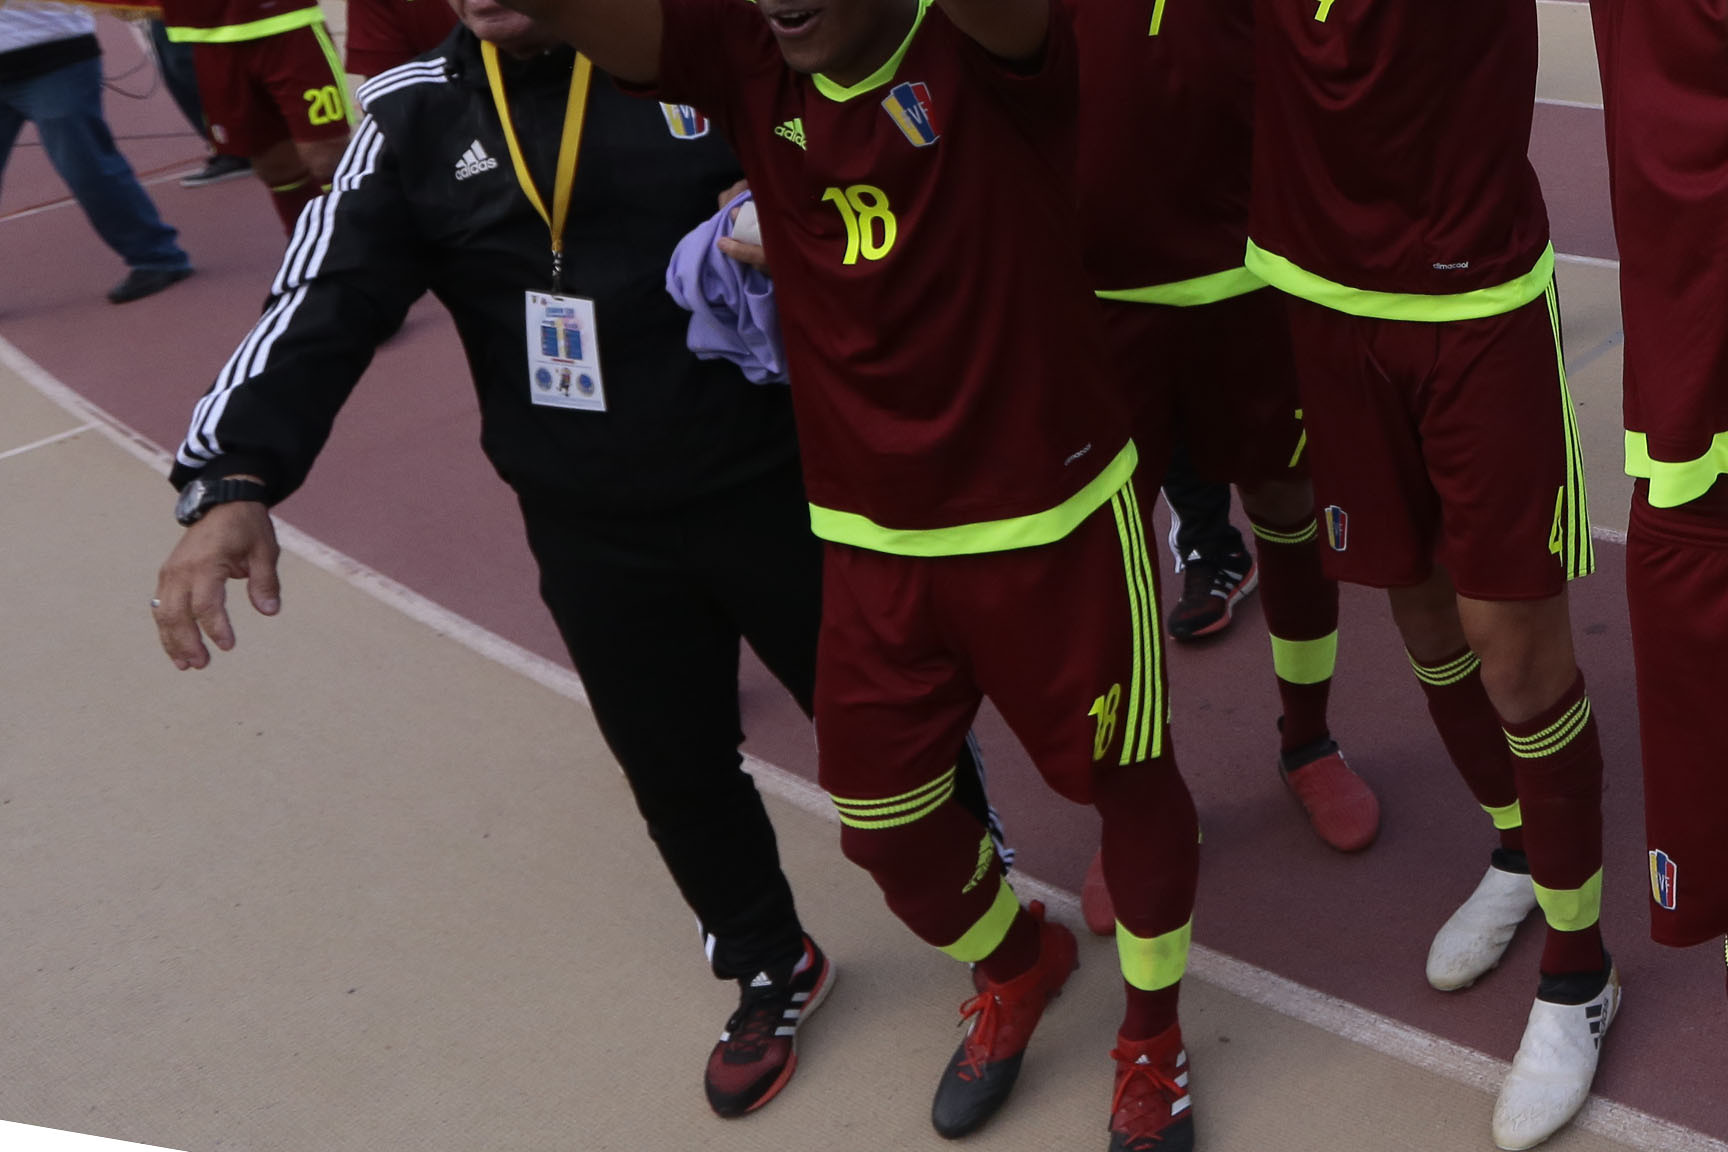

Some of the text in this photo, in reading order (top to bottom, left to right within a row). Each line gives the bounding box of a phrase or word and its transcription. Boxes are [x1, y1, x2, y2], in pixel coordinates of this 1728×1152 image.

[304, 85, 344, 125] 20
[455, 158, 498, 181] adidas
[821, 184, 897, 265] 18
[1432, 261, 1469, 271] climacool
[1088, 682, 1120, 761] 18
